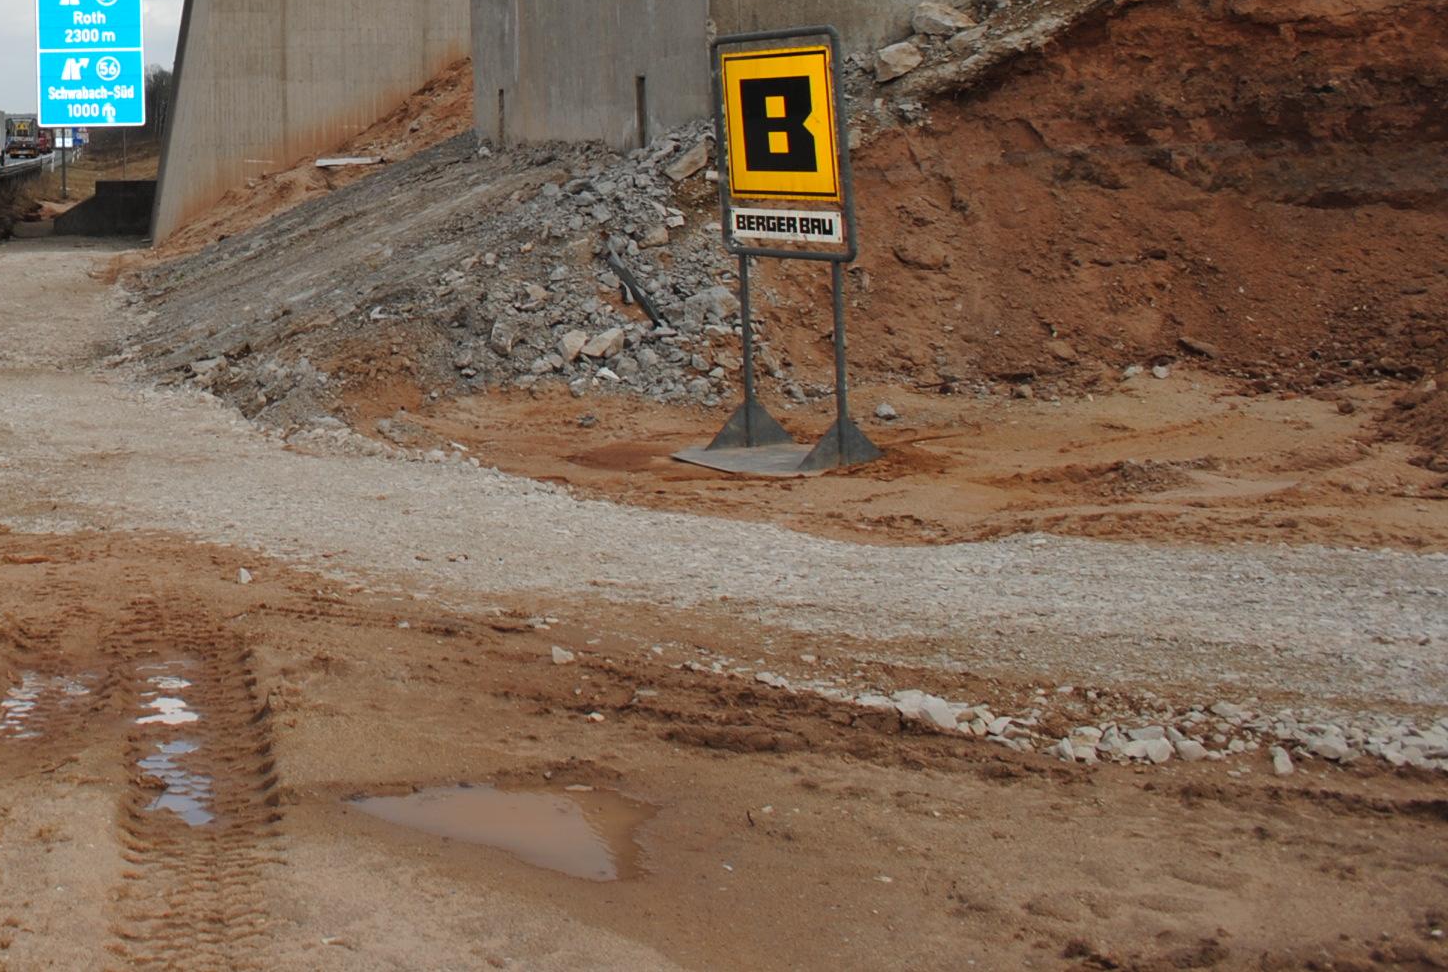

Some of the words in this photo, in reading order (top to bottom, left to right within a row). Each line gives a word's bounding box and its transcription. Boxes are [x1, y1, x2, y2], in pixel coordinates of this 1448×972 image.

[73, 11, 106, 25] Roth
[64, 29, 99, 43] 2300
[101, 31, 116, 42] m
[99, 61, 117, 75] 56
[48, 85, 135, 100] Schwabach-Süd
[67, 104, 99, 117] 1000
[102, 104, 116, 117] m
[740, 76, 817, 172] B
[736, 214, 798, 233] BERGER
[799, 217, 834, 236] BAU
